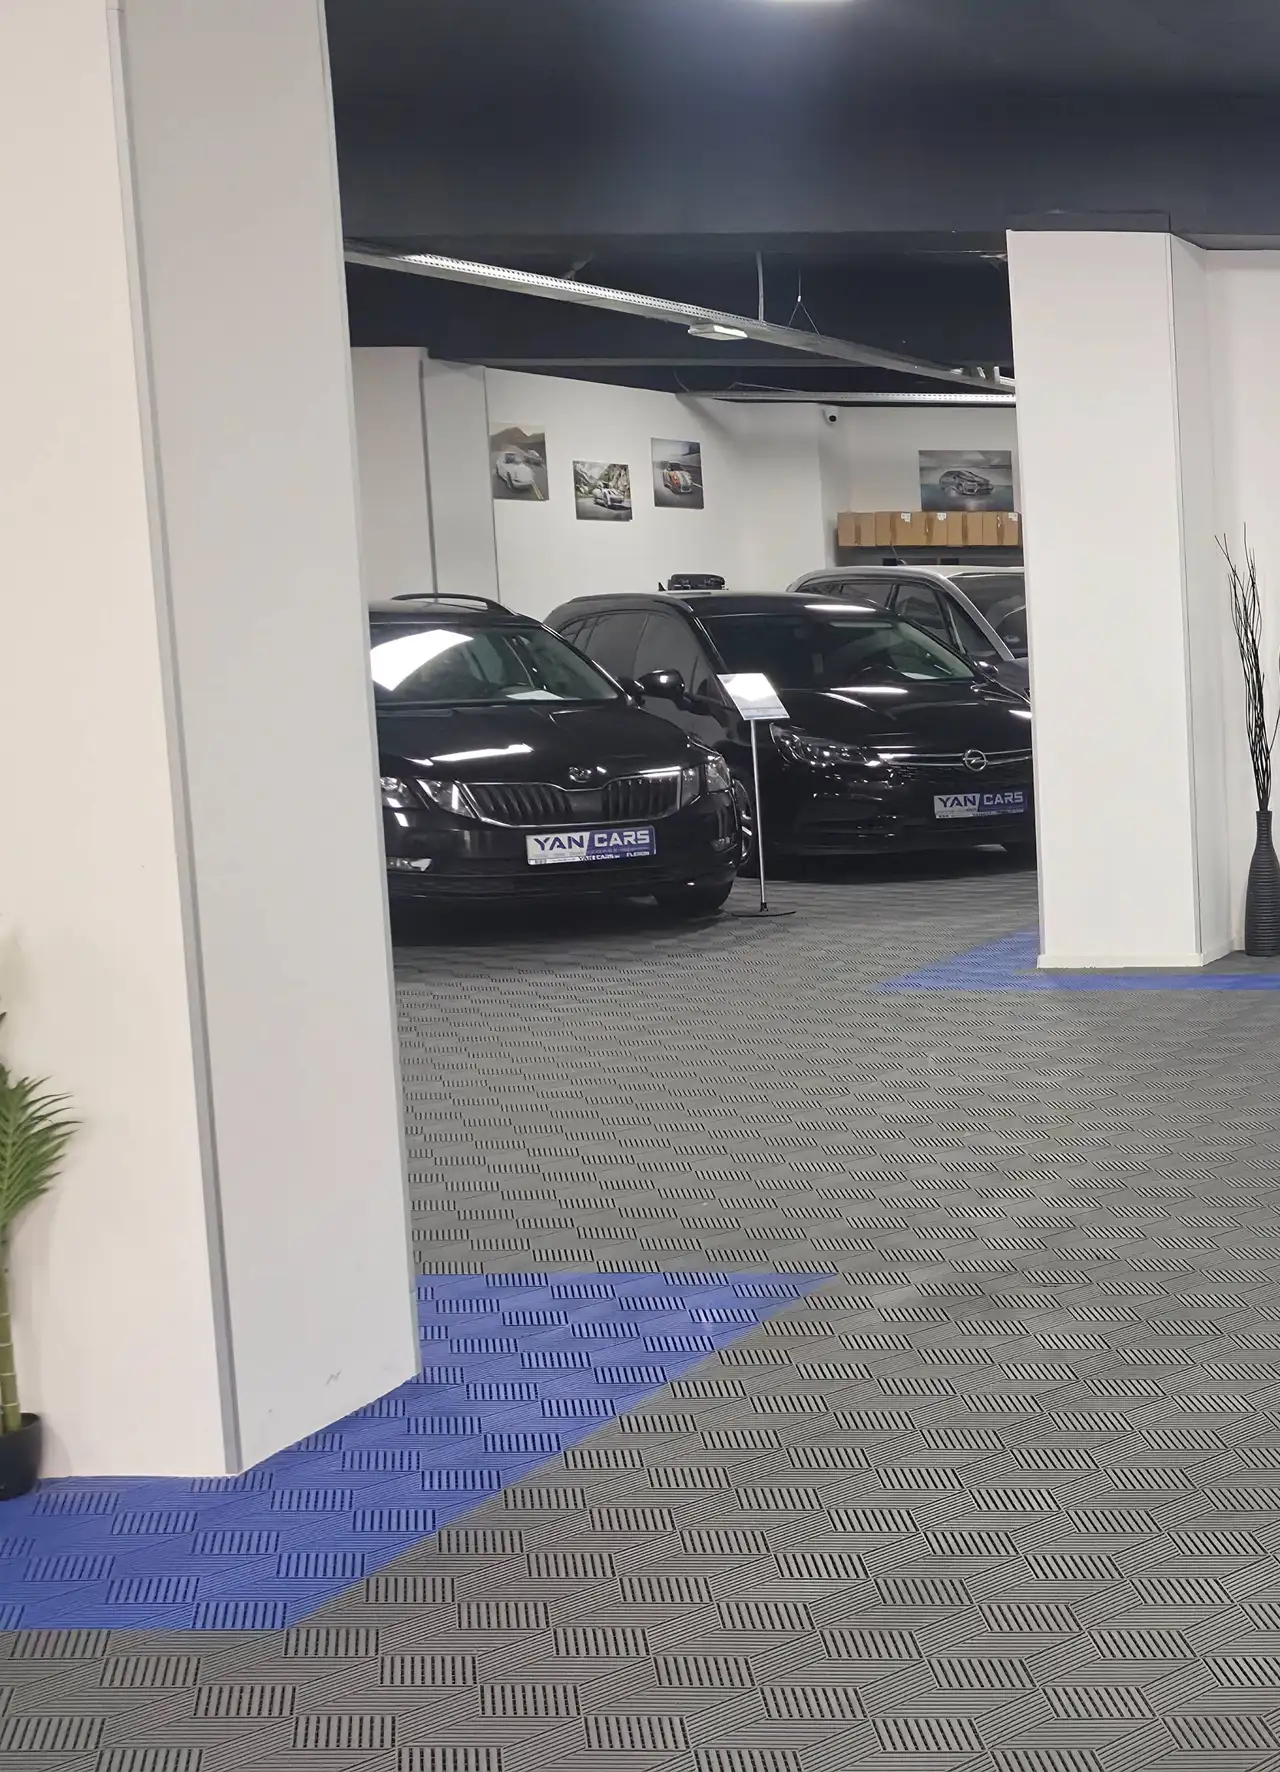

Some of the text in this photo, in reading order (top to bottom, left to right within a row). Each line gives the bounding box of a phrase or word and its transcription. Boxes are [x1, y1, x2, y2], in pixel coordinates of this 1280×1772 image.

[938, 791, 1024, 808] YAN CARS
[533, 829, 650, 851] YAN CARS
